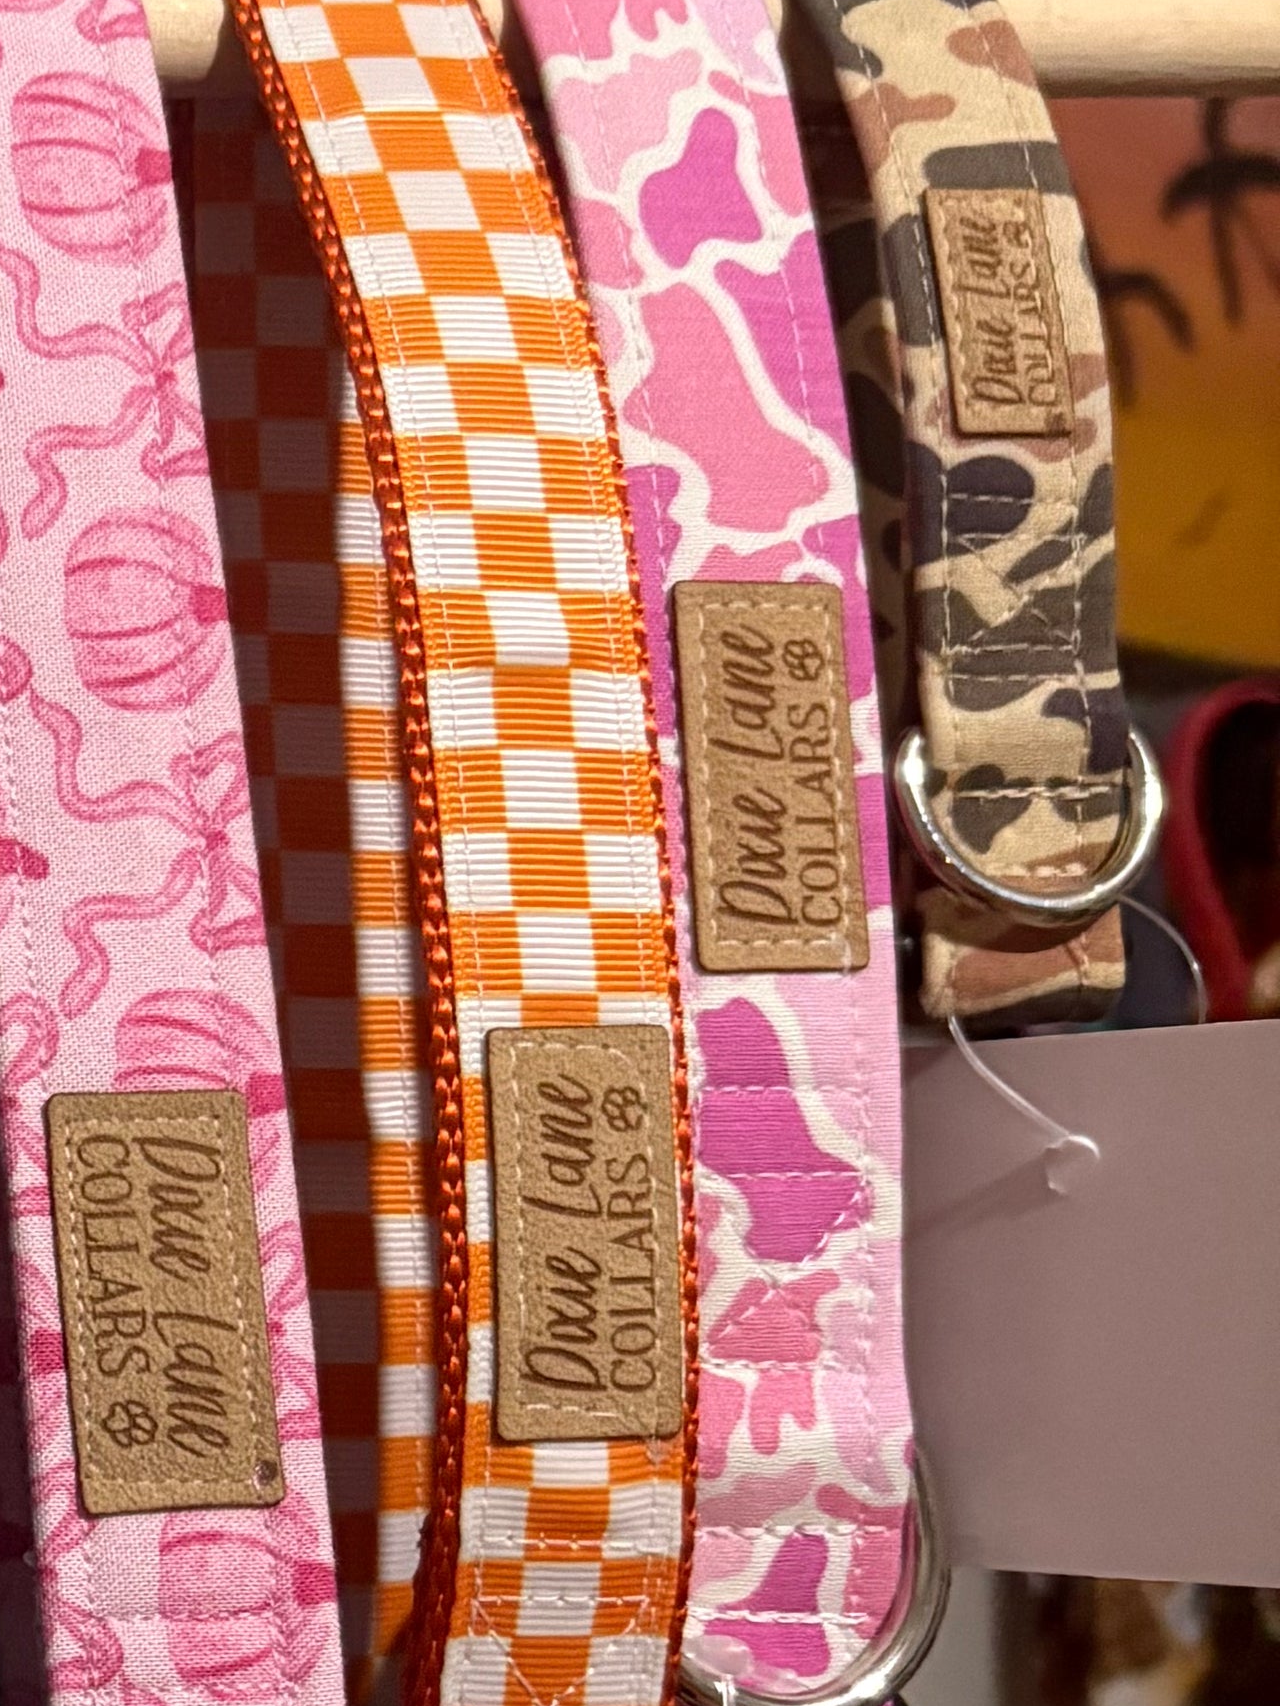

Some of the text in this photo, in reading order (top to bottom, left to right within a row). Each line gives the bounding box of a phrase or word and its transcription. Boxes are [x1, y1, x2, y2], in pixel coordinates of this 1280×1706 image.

[708, 623, 784, 761] Lane
[788, 703, 842, 927] COLLARS
[523, 1073, 602, 1219] Lane
[77, 1133, 151, 1378] COLLARS
[607, 1153, 657, 1392] COLLARS
[152, 1310, 237, 1459] Lane
